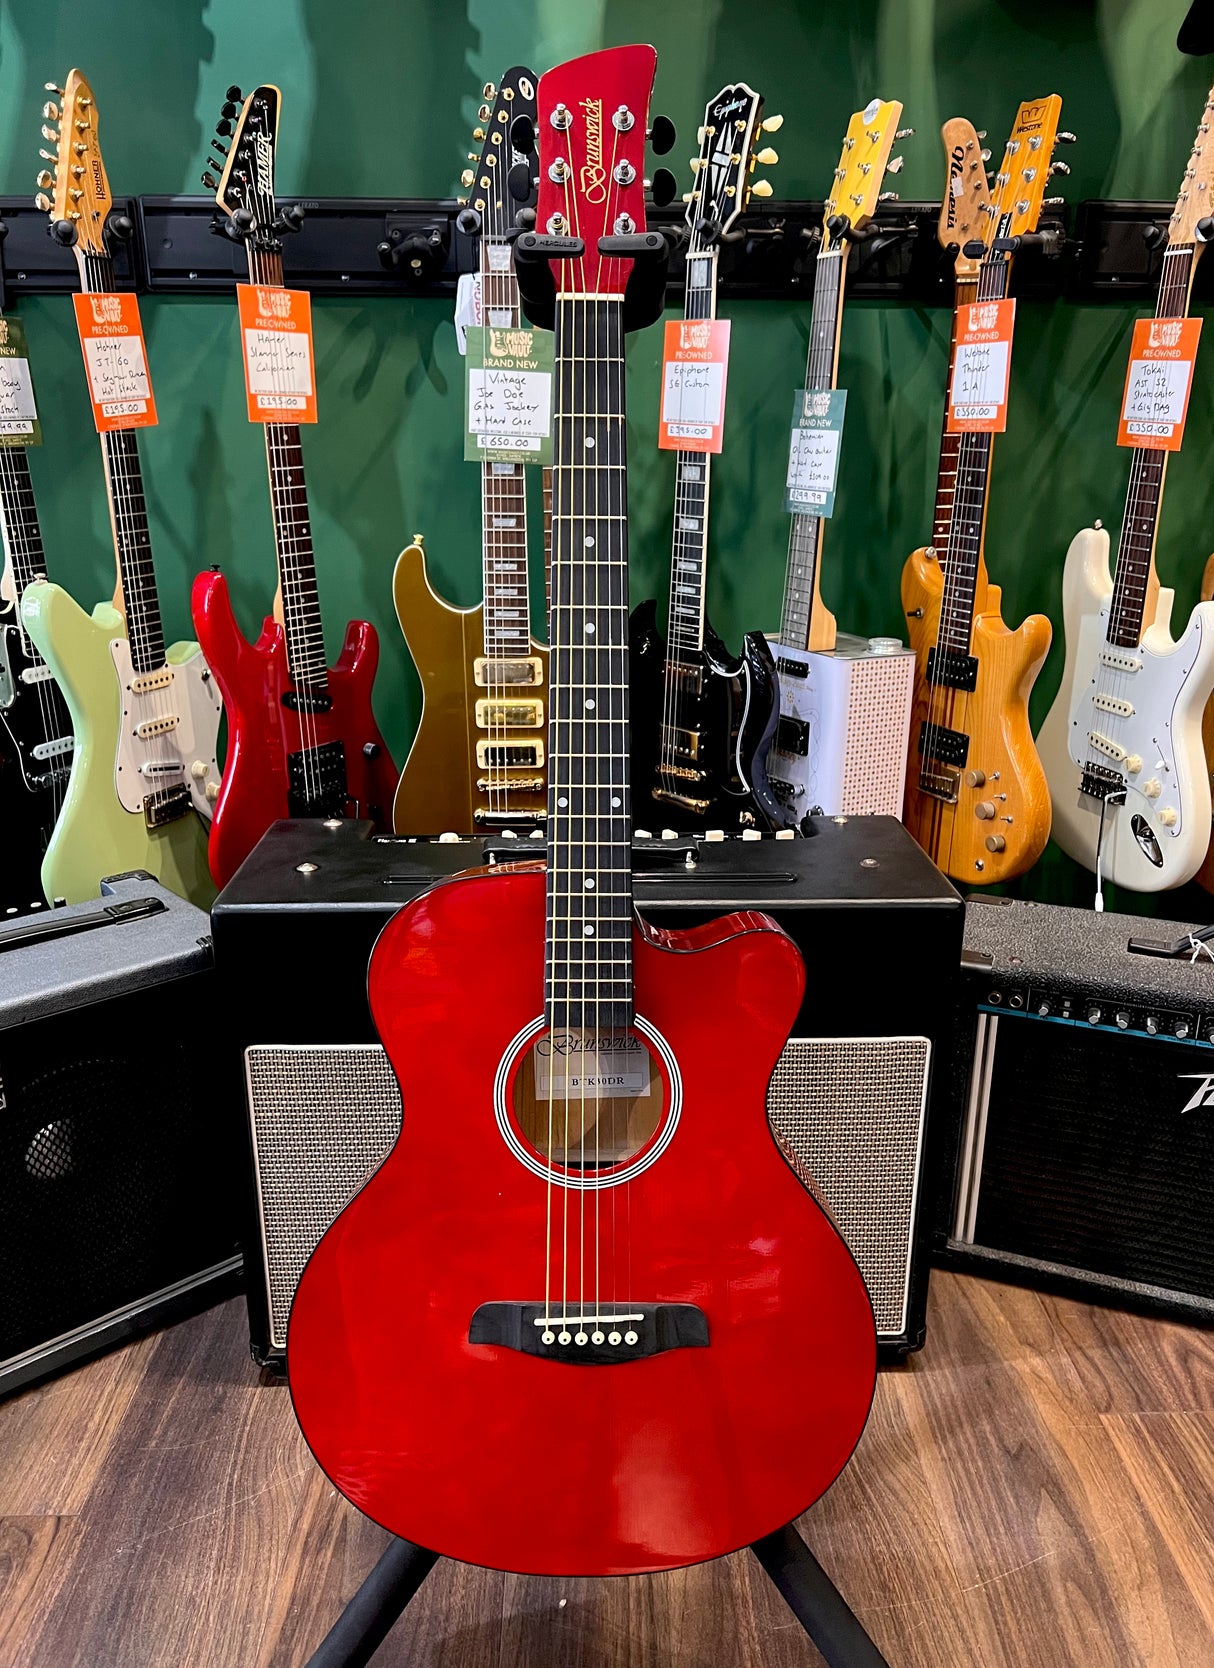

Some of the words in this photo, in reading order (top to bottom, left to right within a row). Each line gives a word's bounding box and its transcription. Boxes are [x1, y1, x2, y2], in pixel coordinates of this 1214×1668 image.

[579, 97, 606, 204] Brunswick
[257, 131, 273, 196] HAMER
[91, 160, 106, 200] HOHNER
[947, 145, 965, 231] Neesis
[539, 239, 578, 248] HERCULES
[506, 331, 533, 346] MUSIC
[0, 347, 16, 355] NEW
[483, 357, 514, 368] BRAND
[516, 359, 539, 369] NEW
[503, 387, 524, 398] Doe
[537, 1034, 641, 1057] Brunswick
